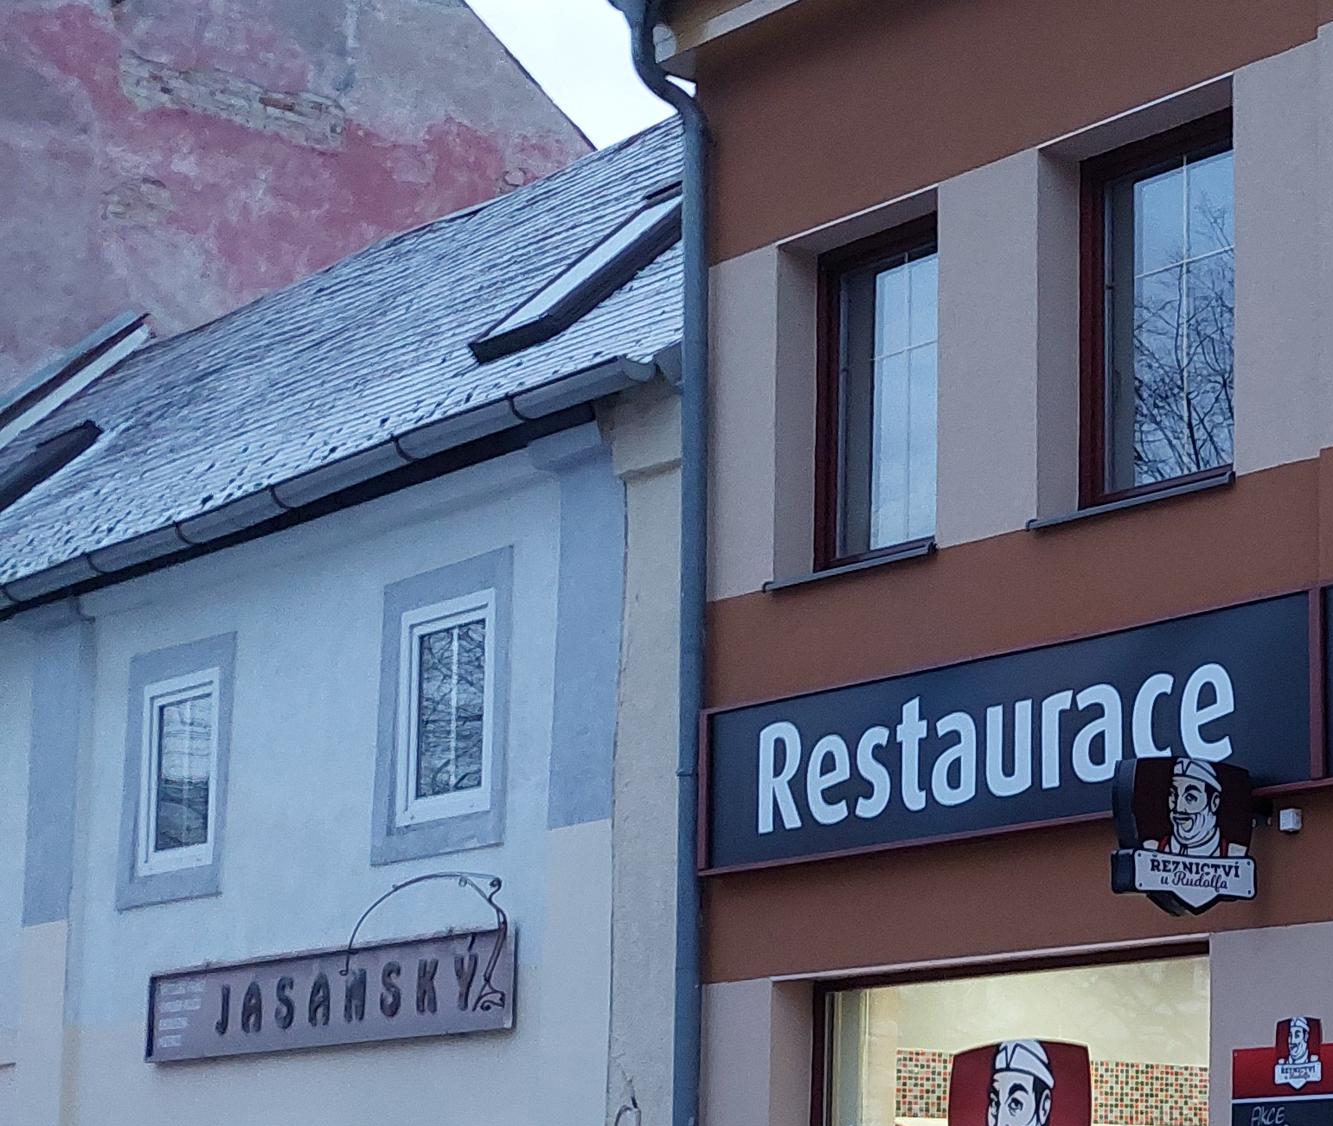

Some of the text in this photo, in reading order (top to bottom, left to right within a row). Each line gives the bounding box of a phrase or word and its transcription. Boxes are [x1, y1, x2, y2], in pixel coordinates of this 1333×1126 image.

[757, 662, 1235, 835] Restaurace
[1150, 853, 1240, 878] ŘEZNICTVÍ
[1172, 870, 1228, 892] Rudolfa
[1251, 1106, 1285, 1126] AKCE
